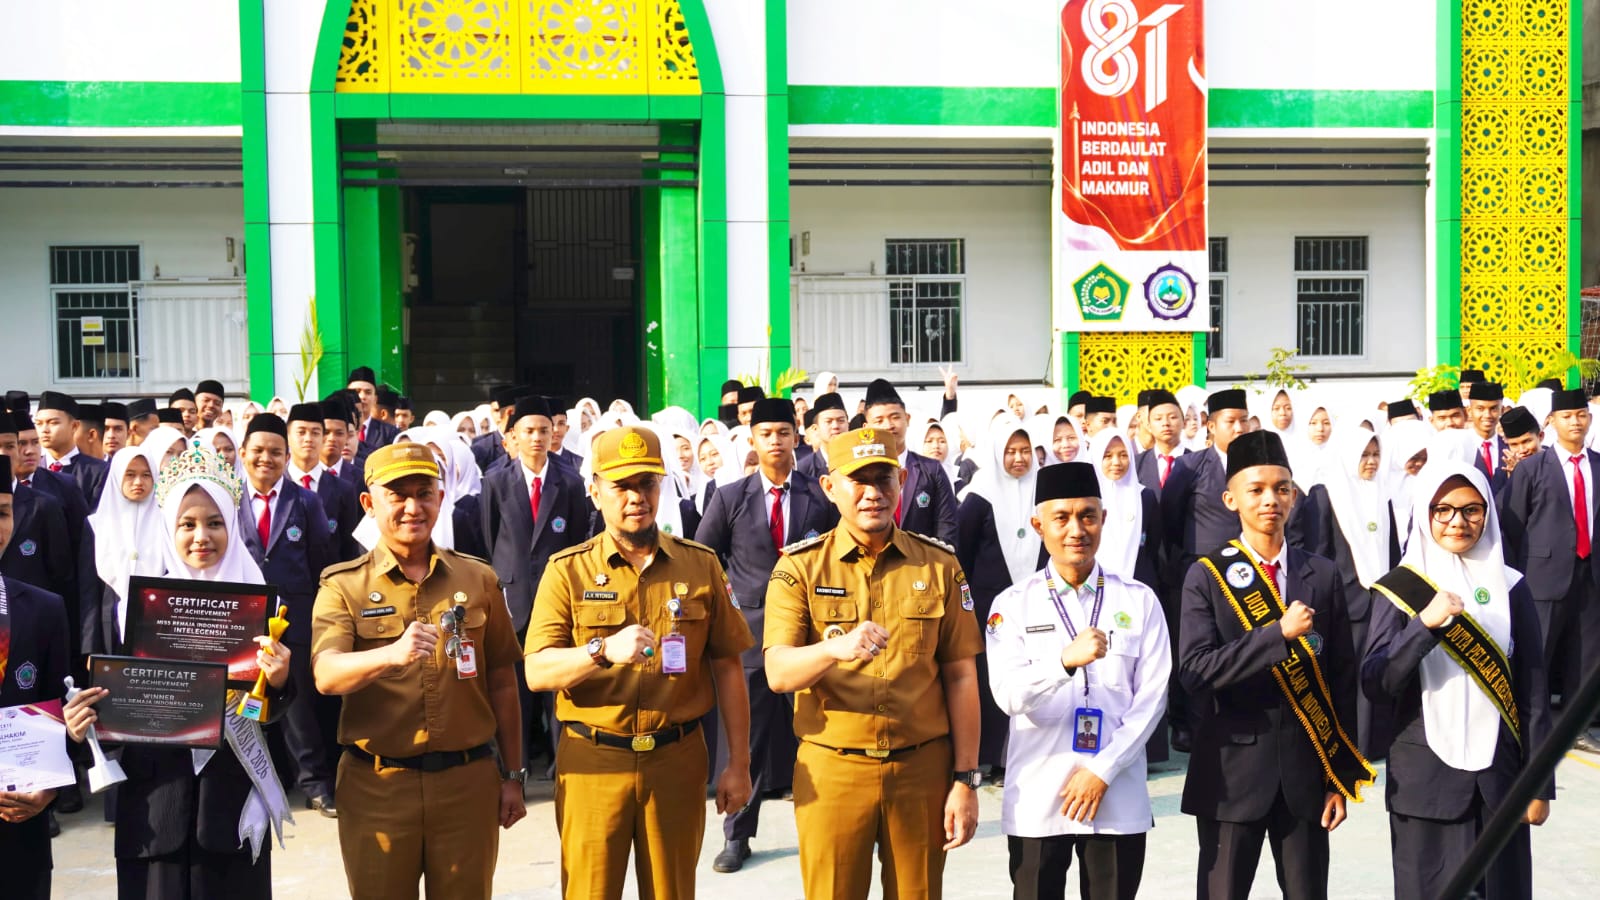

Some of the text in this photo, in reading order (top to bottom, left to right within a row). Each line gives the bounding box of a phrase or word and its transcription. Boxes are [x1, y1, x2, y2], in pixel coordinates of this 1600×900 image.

[1081, 0, 1185, 113] 81
[1082, 121, 1160, 137] INDONESIA
[1082, 141, 1166, 156] BERDAULAT
[1082, 160, 1149, 176] ADIL DAN
[1082, 180, 1150, 195] MAKMUR
[168, 596, 239, 610] CERTIFICATE
[1243, 590, 1271, 621] DUTA
[185, 608, 231, 617] ACHIEVEMENT
[173, 627, 227, 636] INTELEGENSIA
[196, 622, 229, 630] INDONESIA
[1445, 623, 1475, 652] DUTA
[1465, 642, 1500, 684] PELAJAR
[122, 667, 198, 681] CERTIFICATE
[141, 679, 190, 688] ACHIEVEMENT
[143, 693, 175, 701] WINNER
[1300, 691, 1333, 744] INDONESIA
[250, 749, 269, 780] 2026
